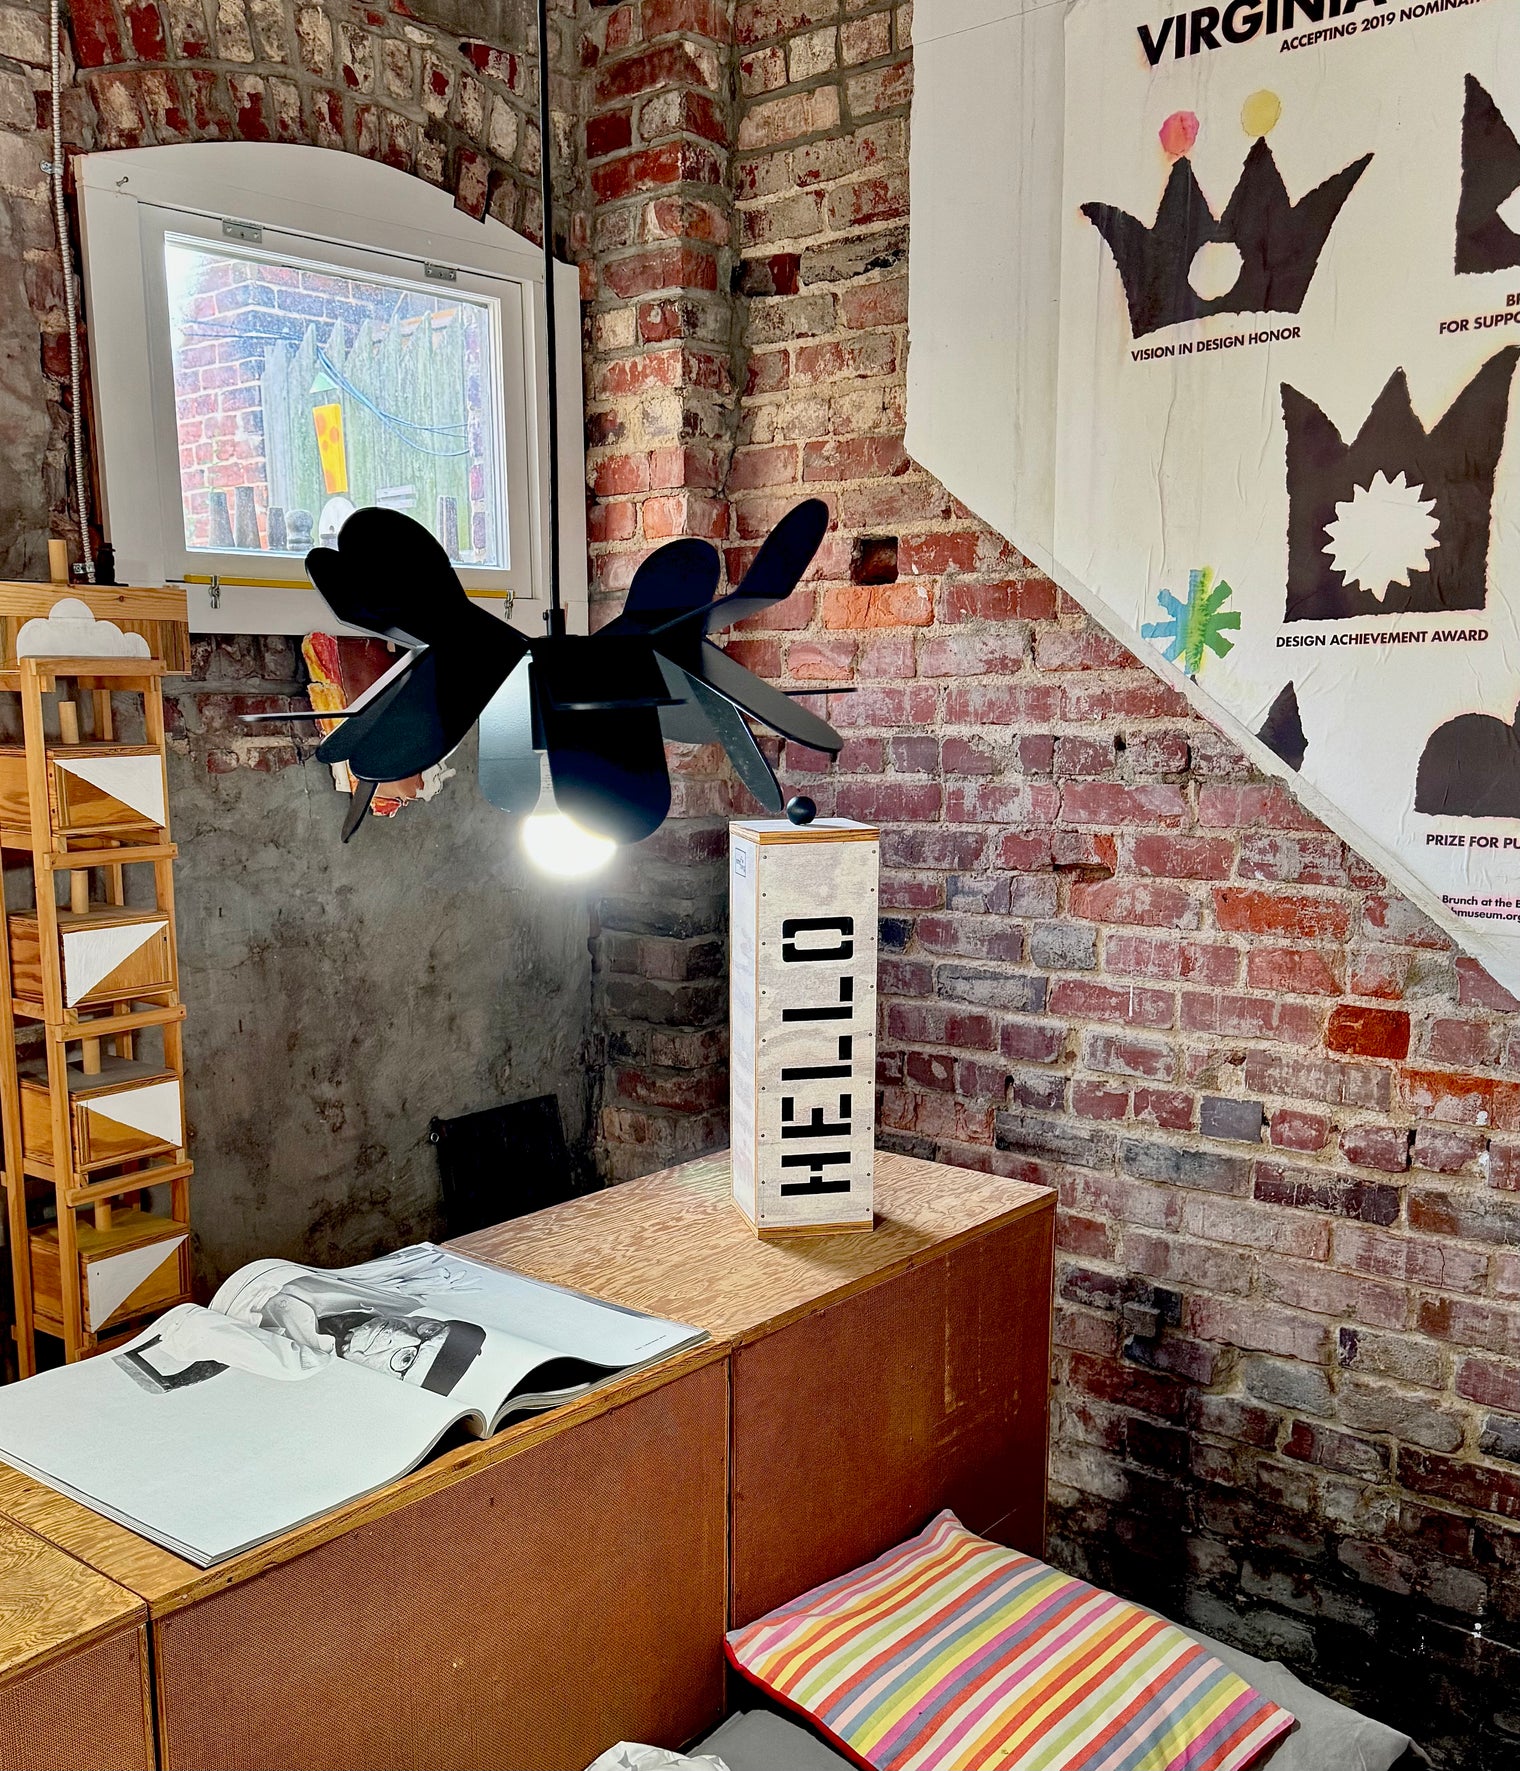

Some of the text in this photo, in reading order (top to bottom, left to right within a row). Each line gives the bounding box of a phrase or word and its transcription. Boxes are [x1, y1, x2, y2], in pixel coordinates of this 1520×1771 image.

[1137, 0, 1387, 66] VIRGIN
[1280, 22, 1357, 53] ACCEPTING
[1361, 12, 1396, 32] 2019
[1439, 319, 1470, 335] FOR
[1131, 326, 1301, 362] VISION IN DESIGN HONOR
[1276, 629, 1489, 648] DESIGN ACHIEVEMENT AWARD
[1426, 834, 1465, 847] PRIZE
[1469, 836, 1499, 848] FOR
[1442, 894, 1478, 906] Brunch
[1481, 898, 1492, 907] at
[1494, 897, 1512, 908] the
[781, 916, 854, 1197] HELLO
